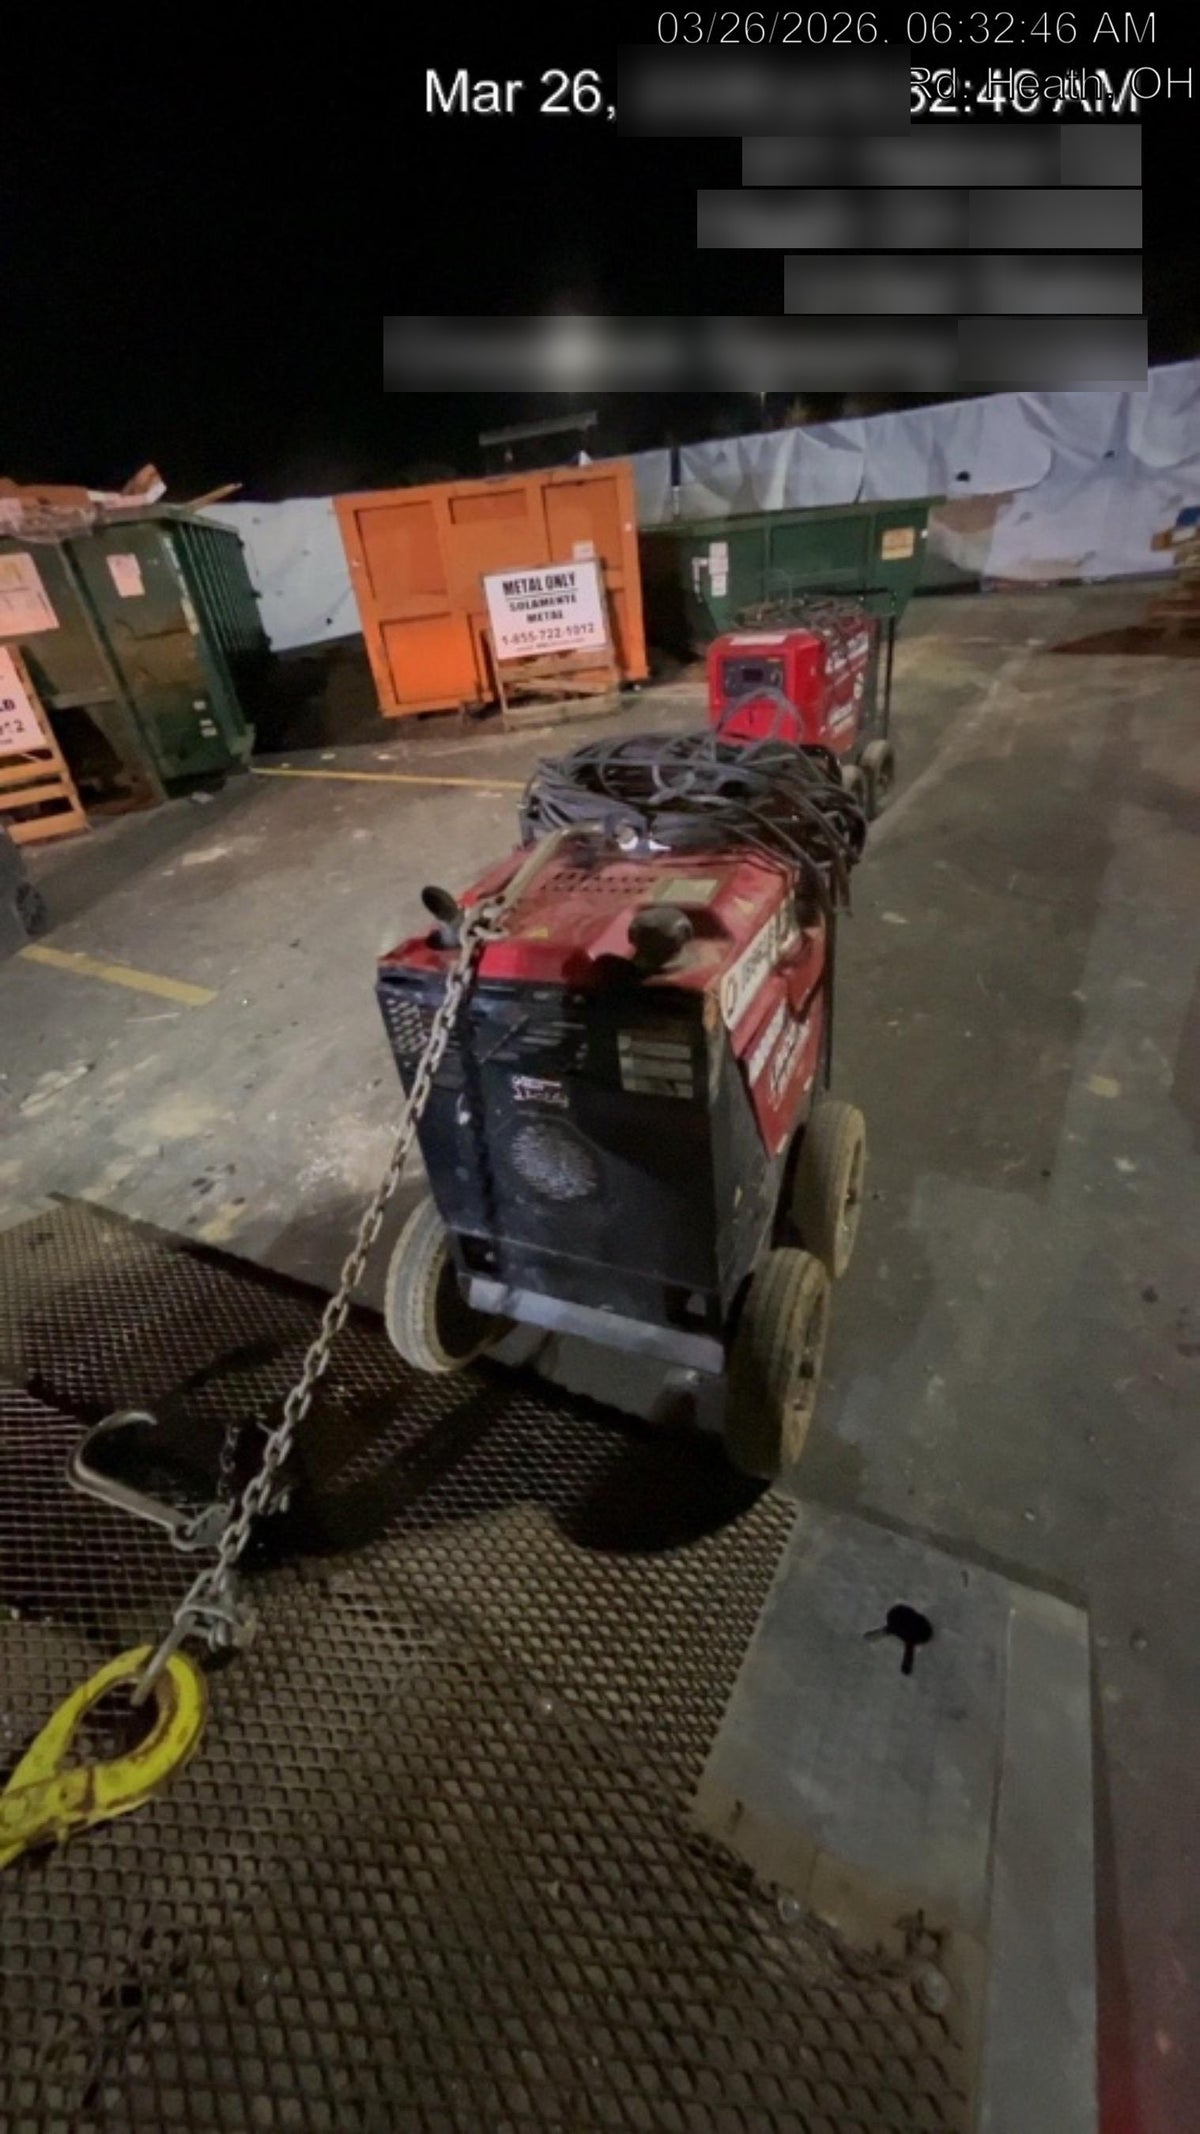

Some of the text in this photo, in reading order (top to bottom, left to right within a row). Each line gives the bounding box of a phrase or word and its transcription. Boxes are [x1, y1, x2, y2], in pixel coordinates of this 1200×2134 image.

[502, 571, 576, 595] METAL ONLY
[509, 594, 577, 612] SOLAMENTE
[526, 610, 564, 623] METAL
